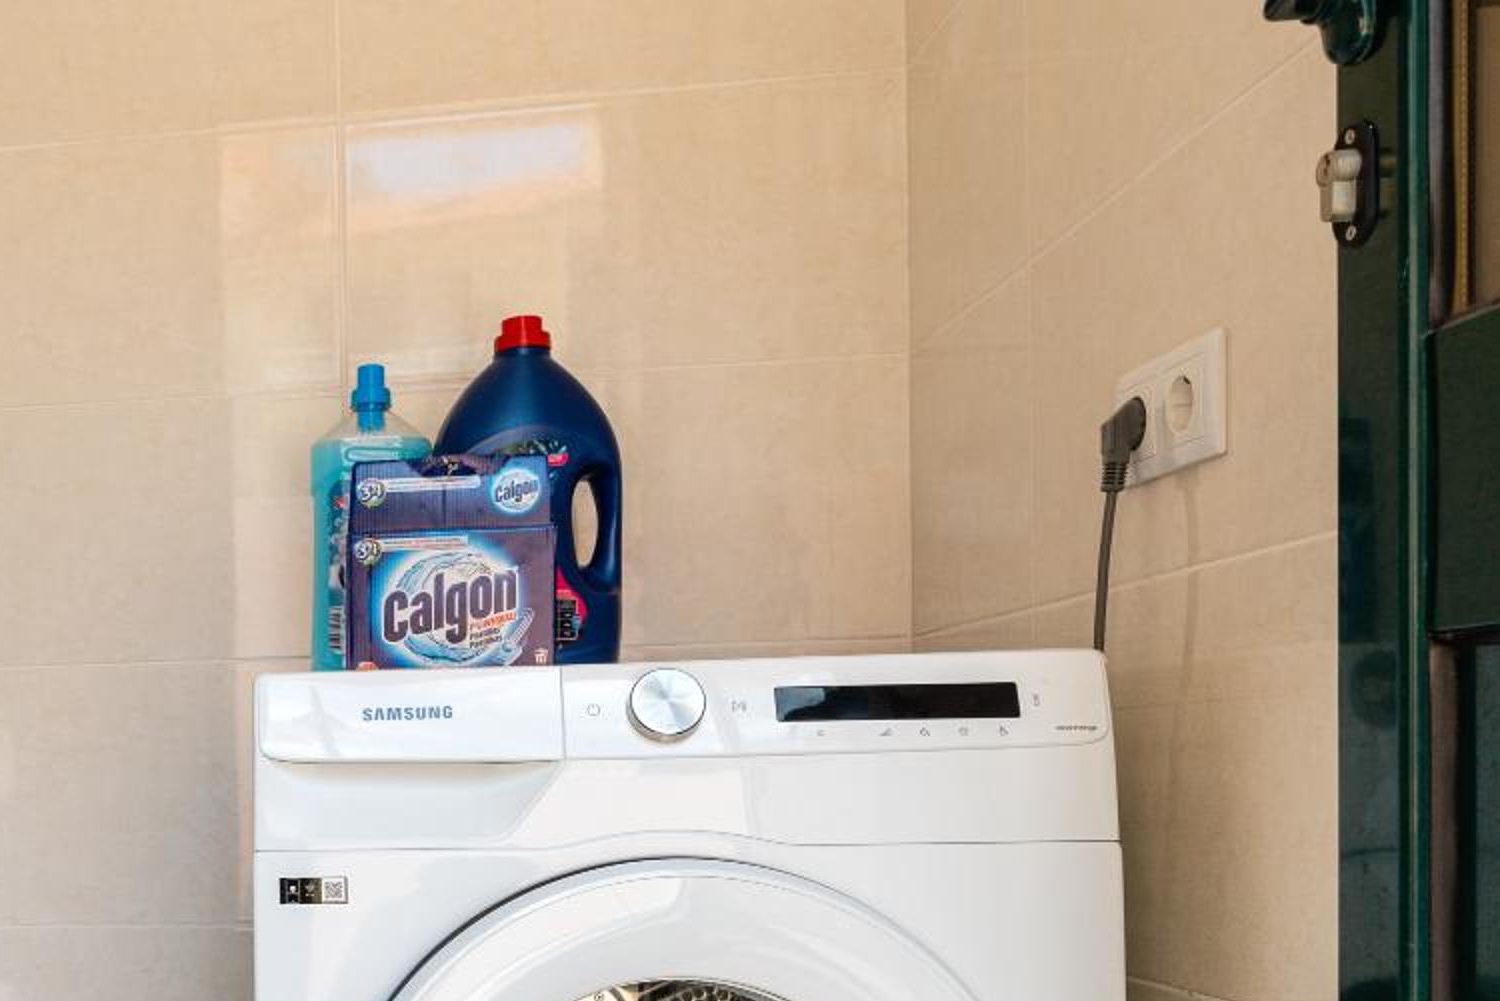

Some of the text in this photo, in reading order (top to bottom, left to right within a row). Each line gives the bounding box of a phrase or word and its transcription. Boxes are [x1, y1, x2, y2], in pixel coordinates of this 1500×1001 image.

[495, 478, 539, 503] Calgon
[383, 568, 518, 645] Calgon
[362, 705, 453, 721] SAMSUNG
